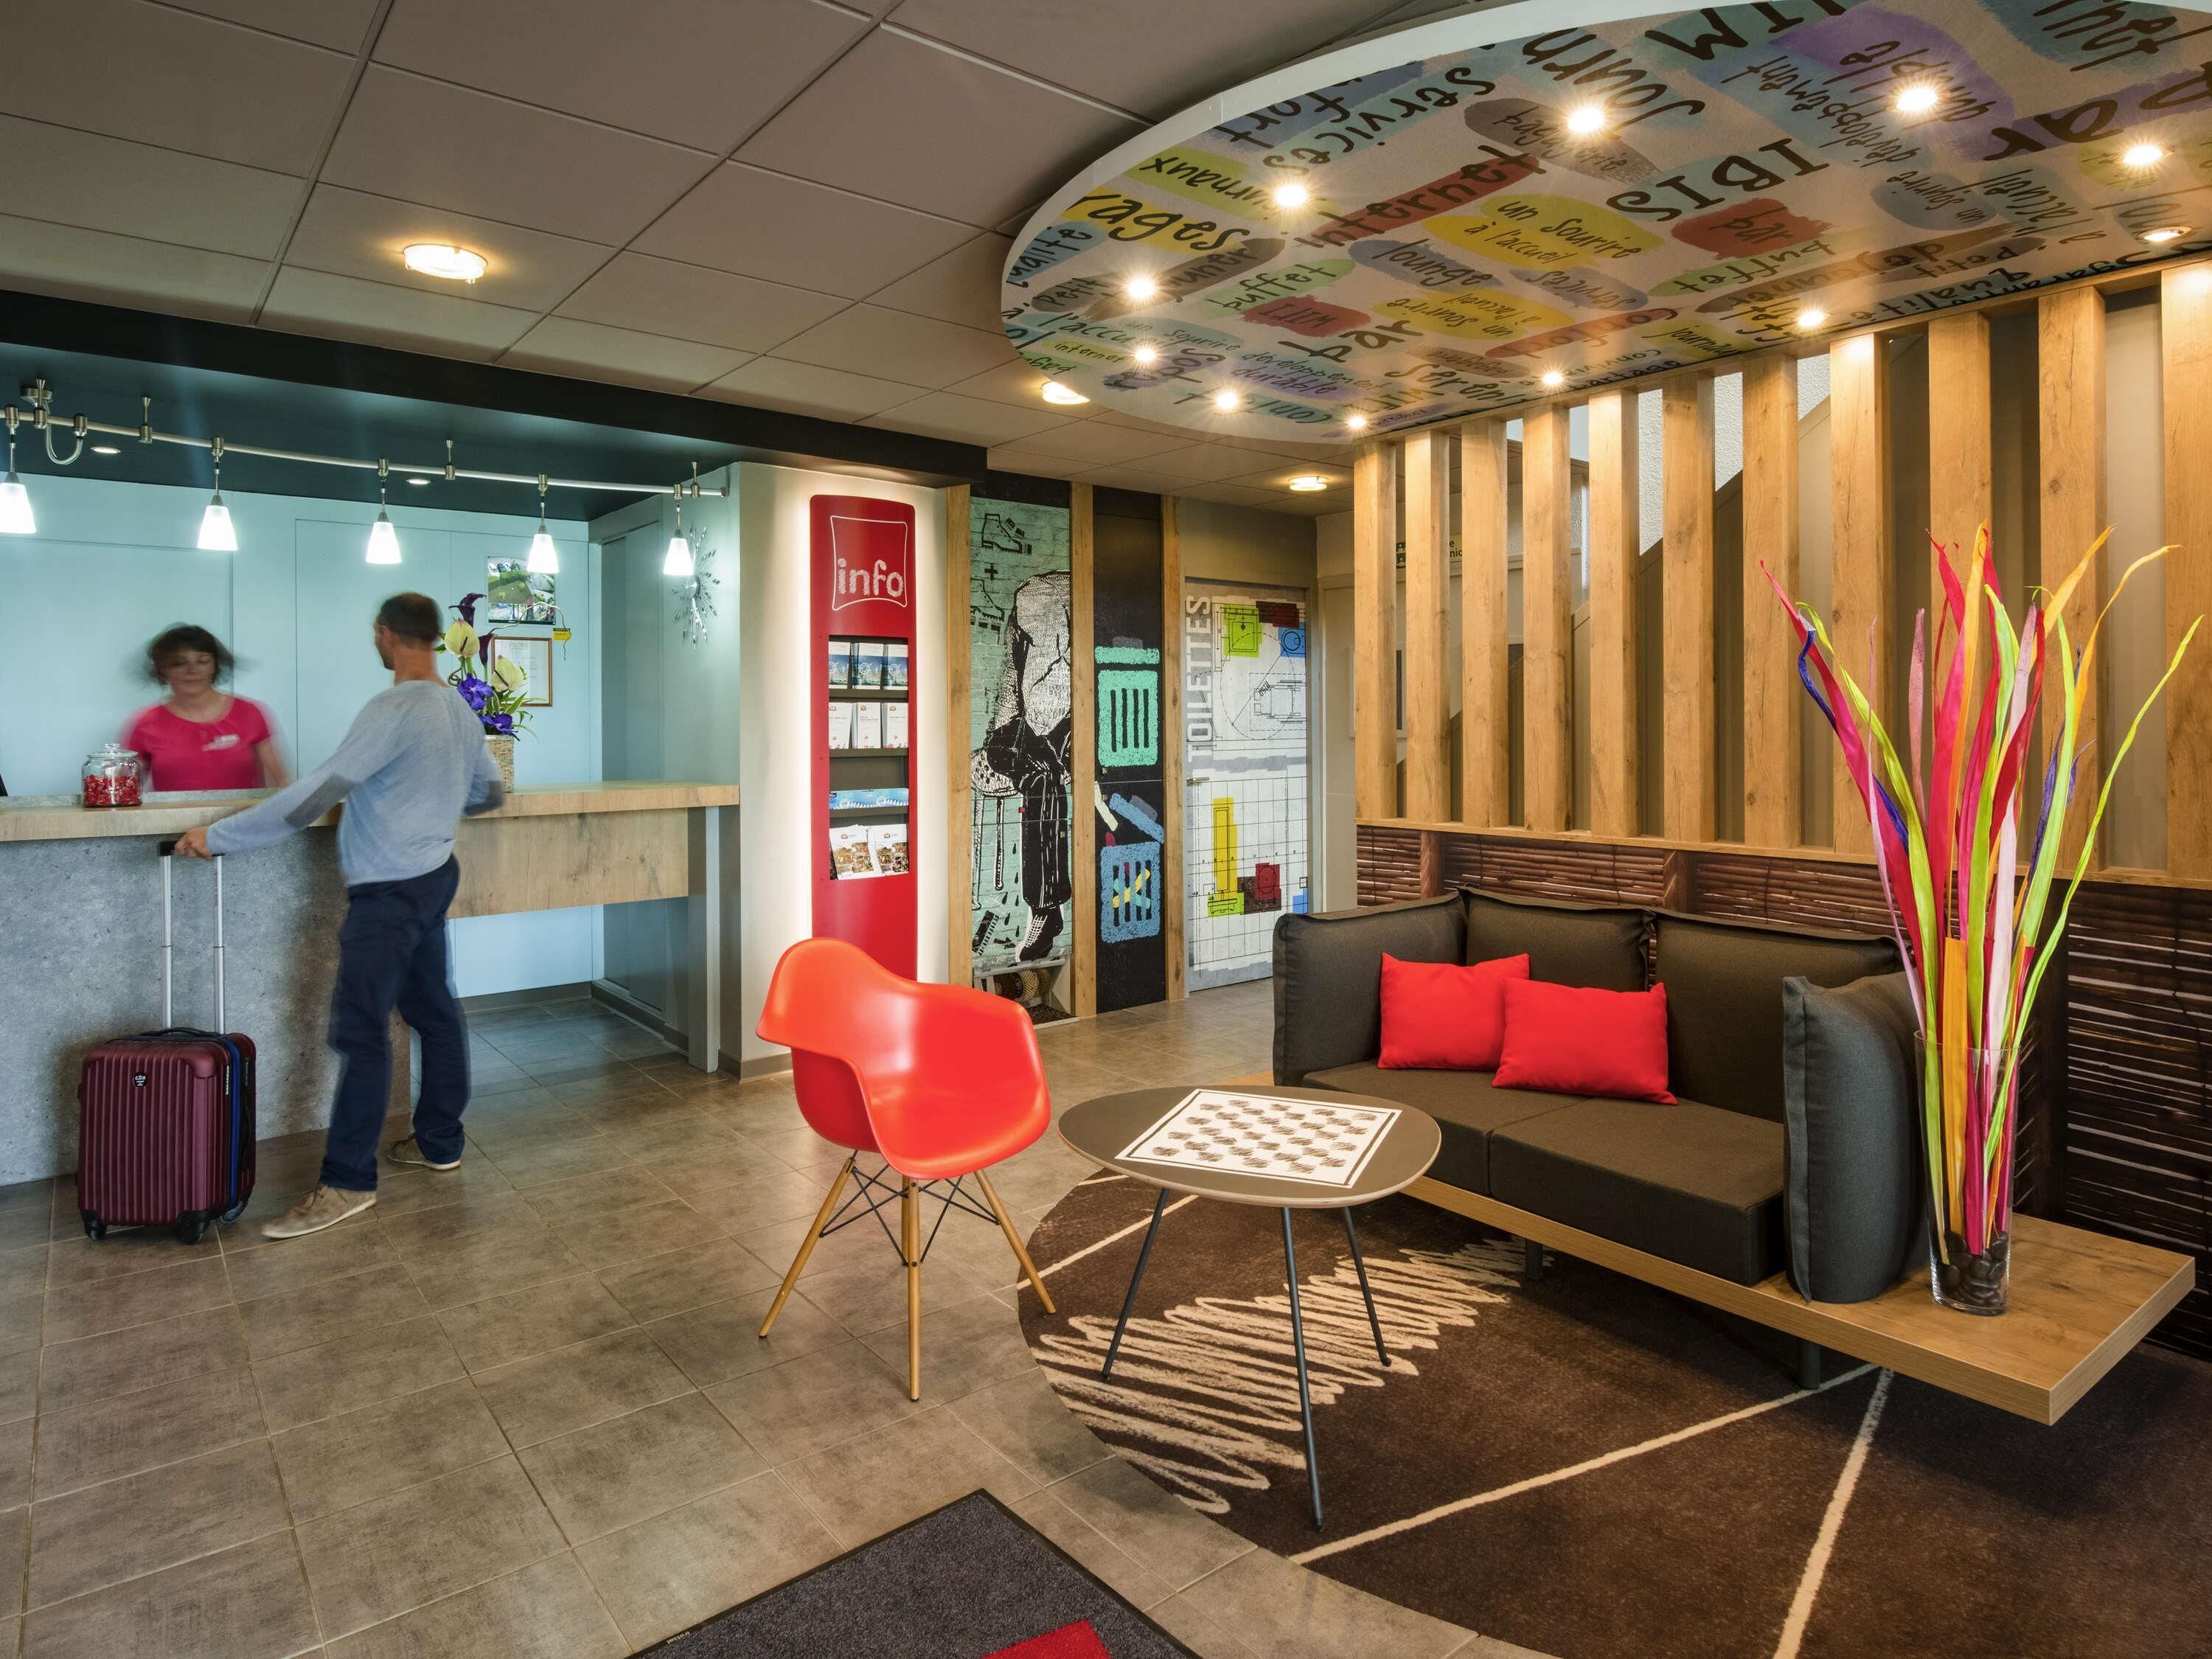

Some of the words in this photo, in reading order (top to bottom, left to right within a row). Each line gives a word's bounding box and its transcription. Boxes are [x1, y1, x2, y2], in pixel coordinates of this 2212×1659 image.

[1821, 41, 1997, 131] duble
[1263, 67, 1496, 176] services
[1280, 145, 1547, 248] internet
[1606, 139, 1830, 221] IBIS
[1484, 229, 1579, 265] l'accueil
[1497, 201, 1539, 221] un
[1540, 218, 1642, 259] sourire
[1371, 238, 1493, 286] lounge
[1673, 240, 1836, 293] buffet
[1206, 264, 1337, 311] buffet
[1526, 270, 1638, 309] services
[1387, 298, 1479, 327] sourire
[1482, 325, 1514, 338] un
[1054, 341, 1129, 364] internet
[1278, 320, 1424, 363] bar
[1231, 367, 1338, 395] durable
[838, 558, 904, 597] info
[1186, 595, 1214, 762] TOILETTES
